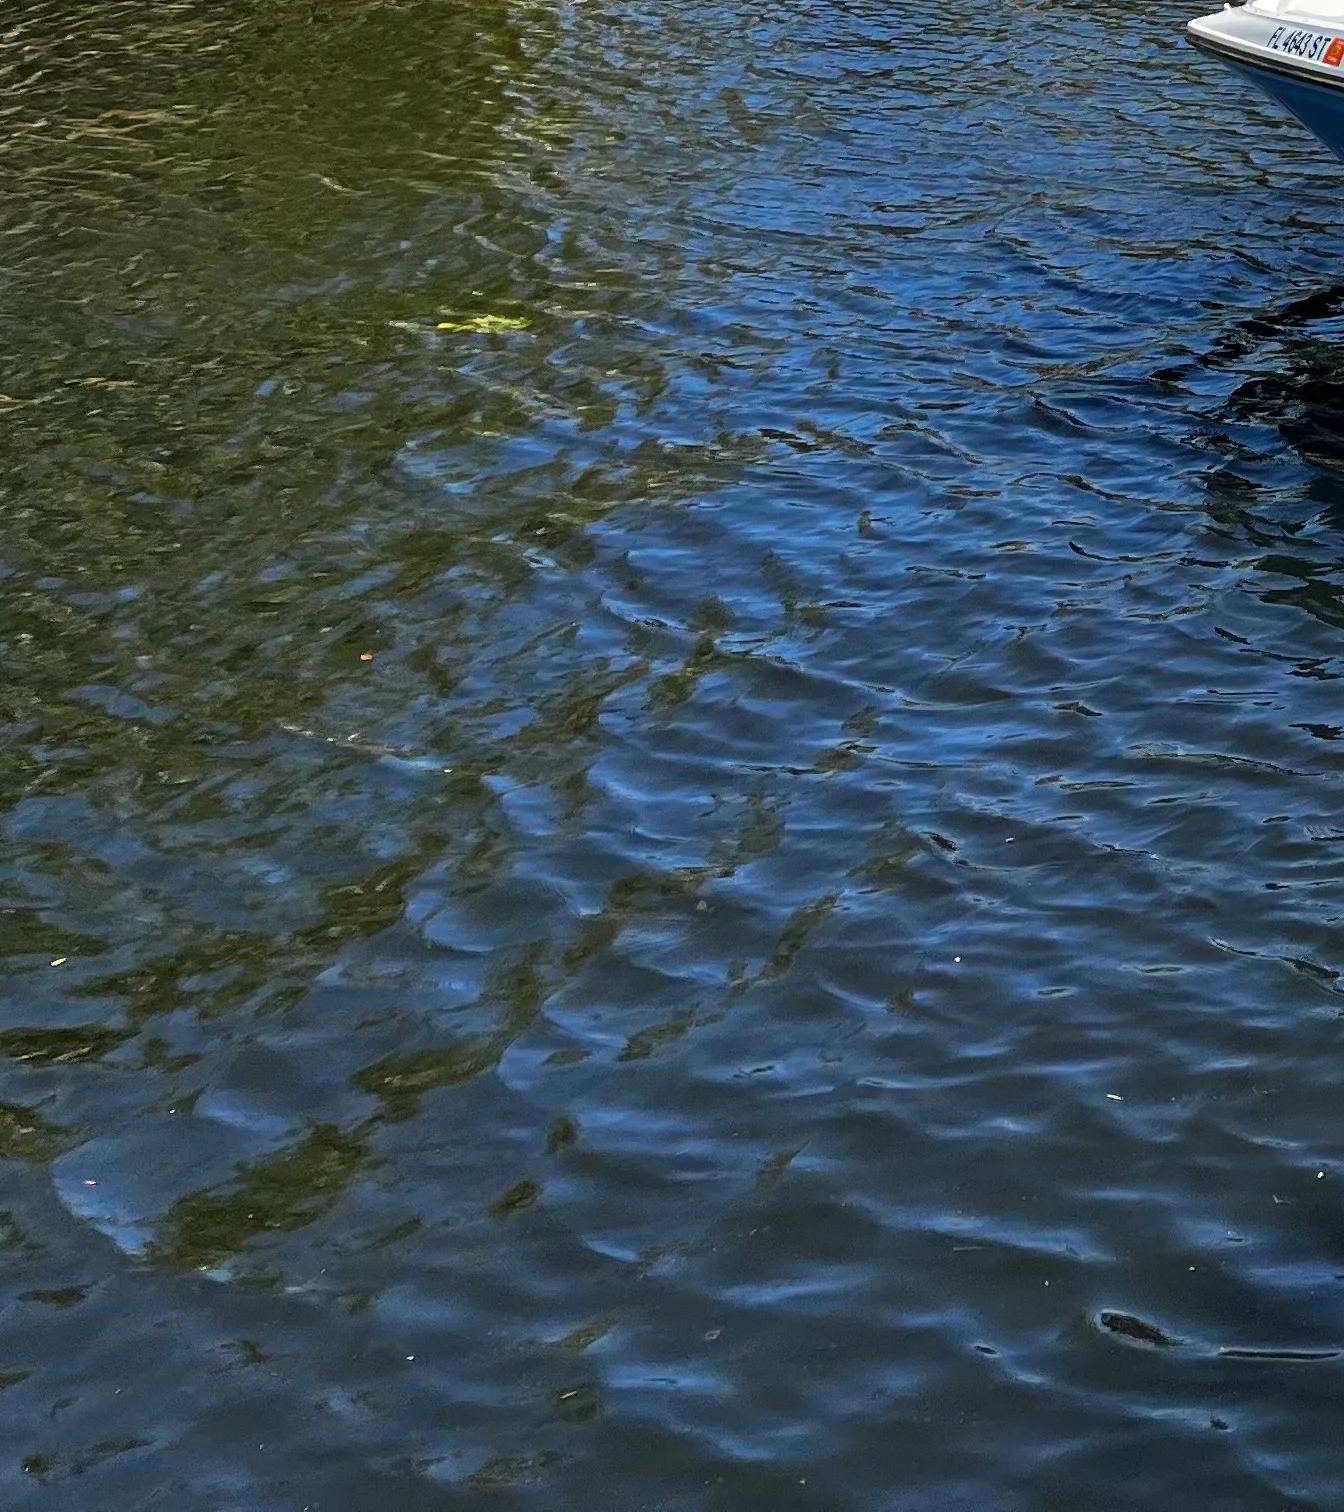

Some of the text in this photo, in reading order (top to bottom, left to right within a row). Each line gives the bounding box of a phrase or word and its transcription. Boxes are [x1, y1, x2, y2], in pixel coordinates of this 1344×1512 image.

[1267, 26, 1286, 49] FL
[1282, 30, 1313, 56] 4643
[1309, 35, 1331, 60] ST
